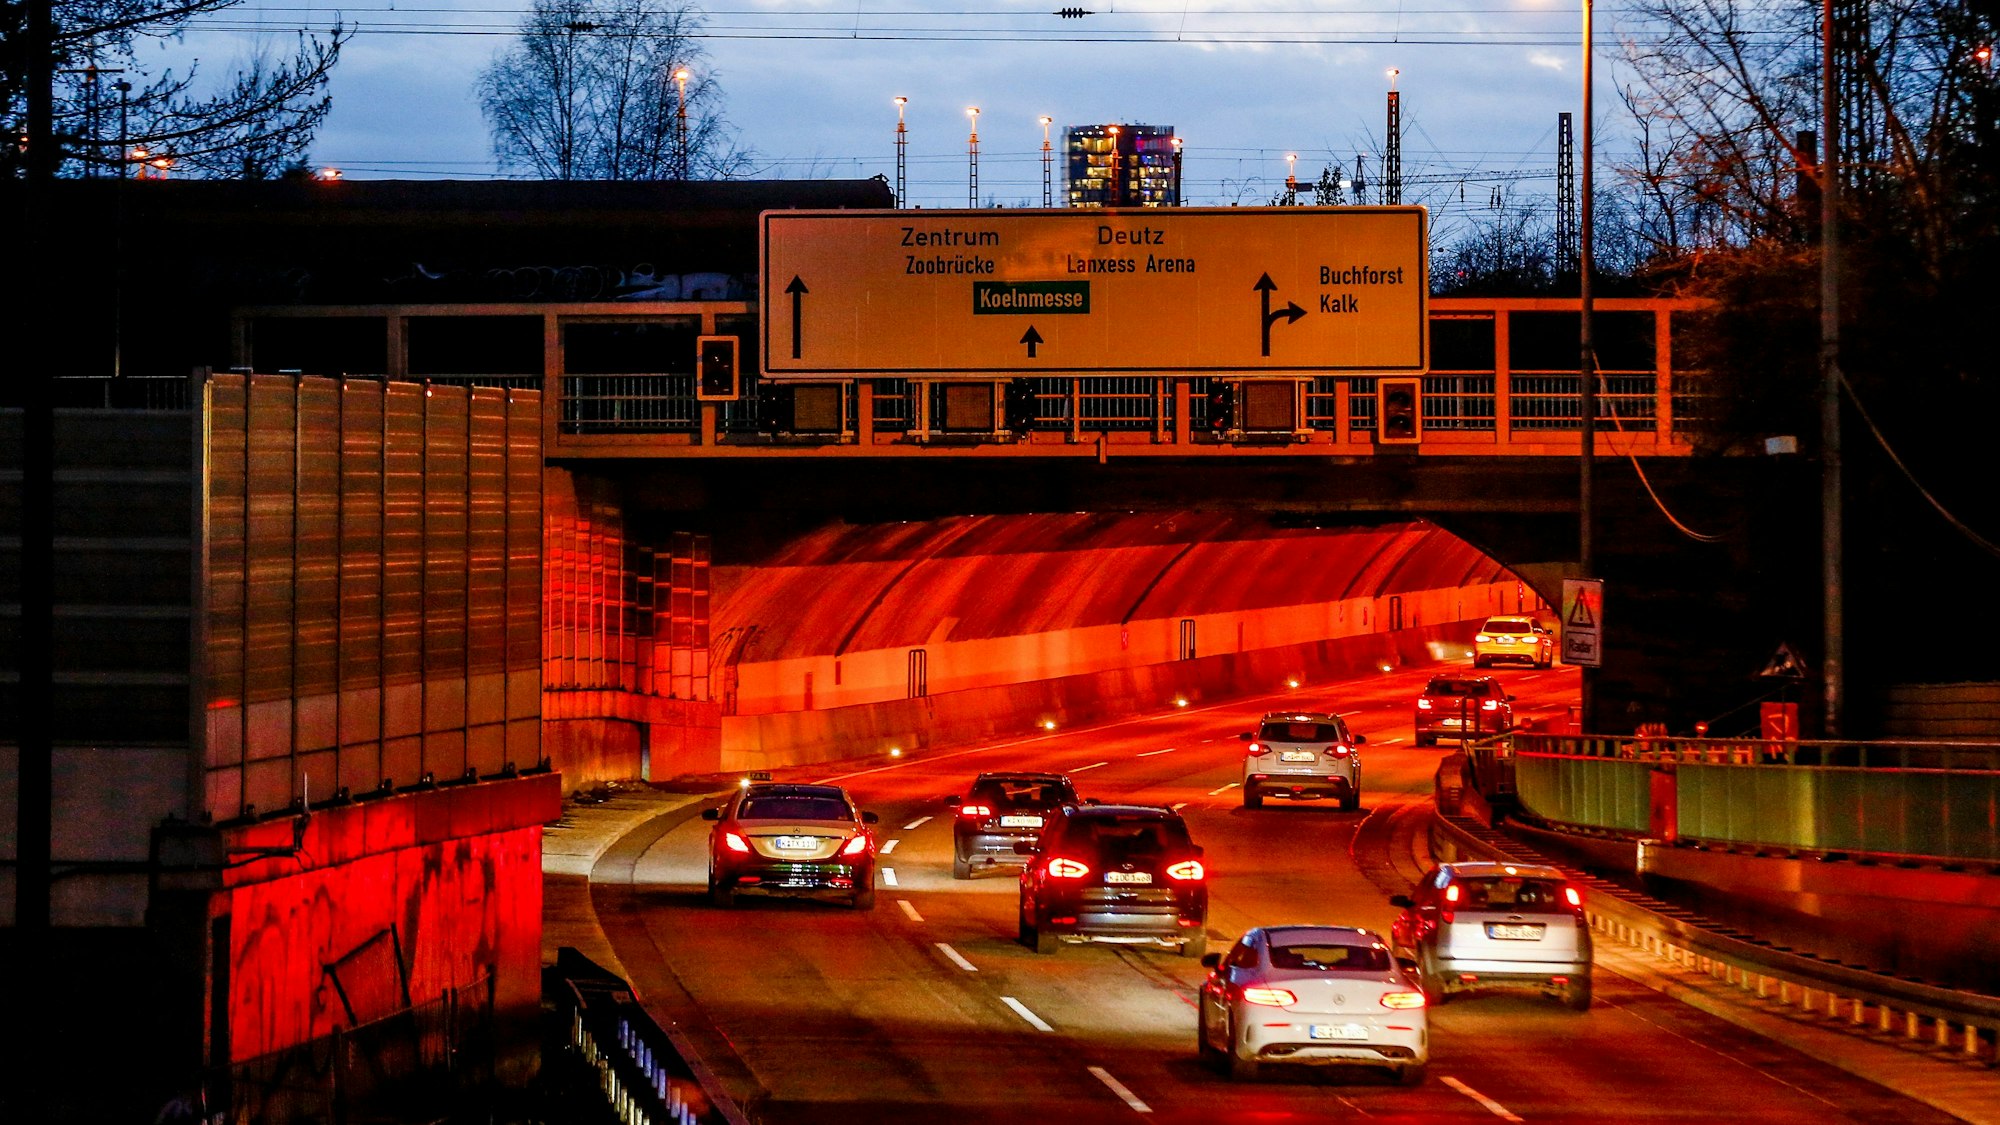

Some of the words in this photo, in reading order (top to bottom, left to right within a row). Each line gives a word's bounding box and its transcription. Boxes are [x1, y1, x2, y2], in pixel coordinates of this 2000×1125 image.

[901, 228, 998, 247] Zentrum
[1098, 226, 1165, 246] Deutz
[905, 254, 995, 275] Zoobrücke
[1067, 254, 1136, 274] Lanxess
[1145, 253, 1196, 273] Arena
[1320, 265, 1404, 286] Buchforst
[979, 287, 1083, 309] Koelnmesse
[1320, 293, 1359, 314] Kalk
[1568, 638, 1593, 654] Radar
